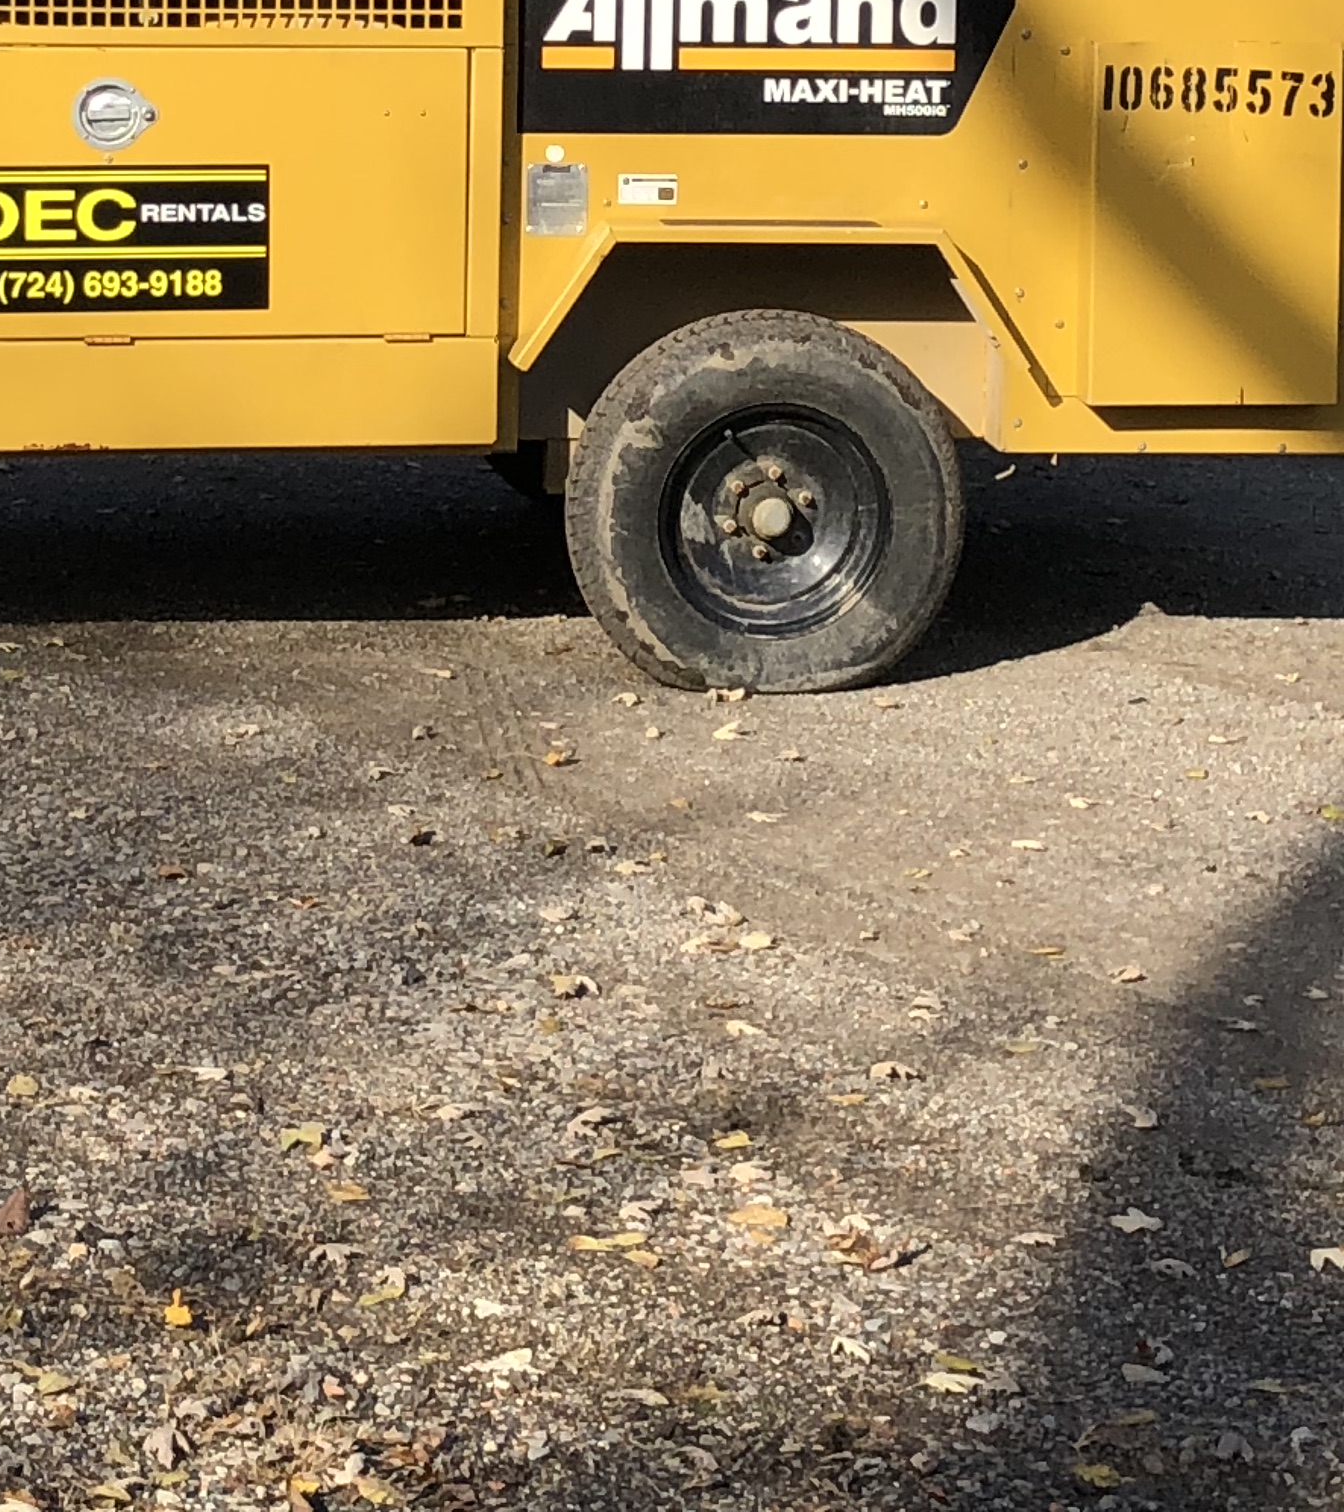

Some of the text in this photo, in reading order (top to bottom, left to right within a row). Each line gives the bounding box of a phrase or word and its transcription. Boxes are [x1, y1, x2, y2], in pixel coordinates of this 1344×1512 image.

[763, 77, 949, 104] MAXI-HEAT
[1103, 64, 1336, 119] 10685573
[140, 202, 266, 224] RENTALS
[83, 269, 223, 298] 693-9188
